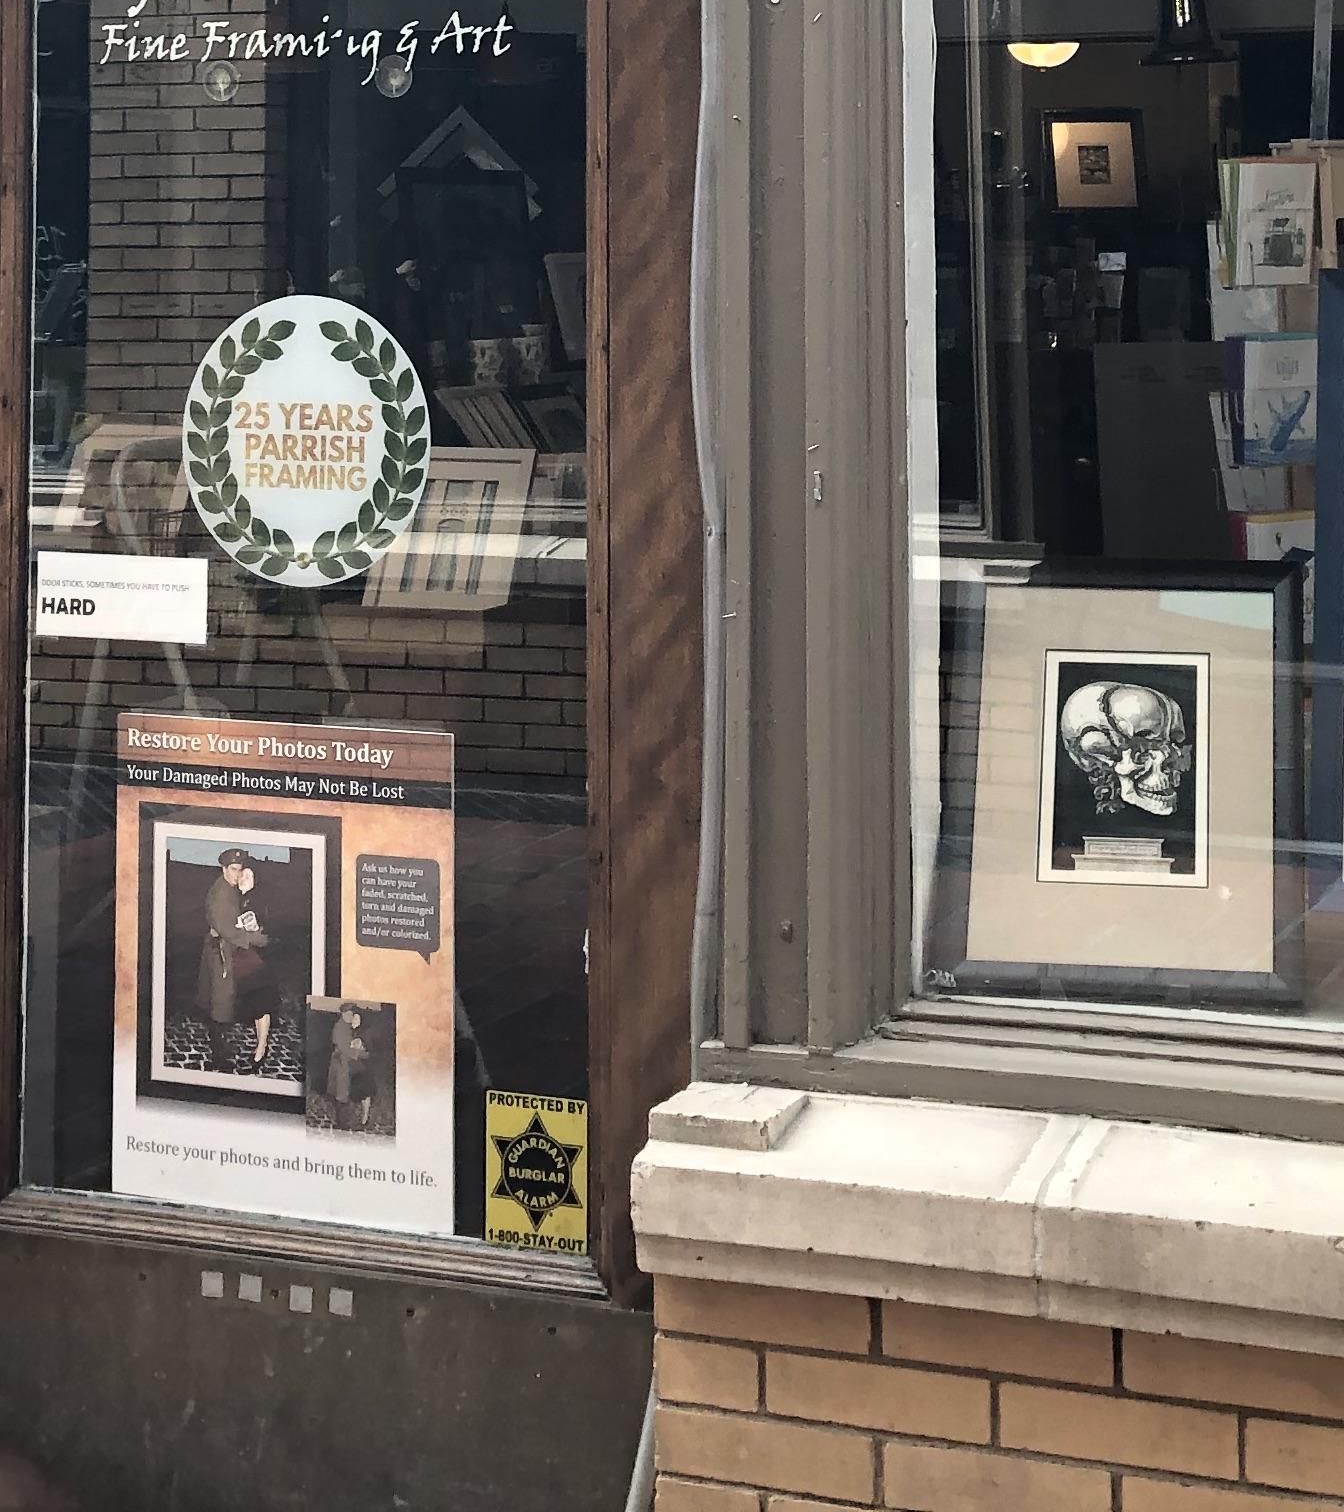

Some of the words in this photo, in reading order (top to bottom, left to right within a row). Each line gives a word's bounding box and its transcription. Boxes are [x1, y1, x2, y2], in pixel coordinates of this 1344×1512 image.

[100, 21, 192, 66] Fine
[396, 19, 421, 73] &
[430, 10, 514, 58] Art
[234, 401, 270, 431] 25
[279, 401, 374, 434] YEARS
[245, 432, 367, 464] PARRISH
[244, 462, 367, 492] FRAMING
[41, 578, 61, 587] DOOR
[86, 581, 126, 590] SOMETIMES
[127, 582, 141, 591] YOU
[142, 583, 159, 592] HAVE
[161, 583, 170, 592] TO
[171, 584, 190, 593] PUSH
[41, 597, 96, 616] HARD
[127, 727, 202, 753] Restore
[206, 733, 254, 756] Your
[257, 737, 327, 761] Photos
[332, 741, 394, 770] Today
[127, 764, 159, 783] Your
[162, 766, 228, 790] Damaged
[232, 771, 281, 792] Photos
[285, 775, 316, 797] May
[318, 778, 346, 796] Not
[349, 781, 369, 798] Be
[372, 783, 405, 800] Lost
[361, 862, 377, 872] Ask
[389, 865, 407, 875] how
[408, 868, 424, 878] you
[361, 877, 376, 885] can
[377, 877, 396, 887] have
[397, 879, 417, 889] your
[361, 888, 386, 899] faded,
[387, 891, 429, 903] scratched,
[361, 902, 379, 911] torn
[380, 902, 396, 912] and
[397, 904, 435, 917] damaged
[361, 914, 389, 924] photos
[390, 916, 425, 928] restored
[361, 926, 390, 937] and/or
[391, 929, 432, 941] colorized.
[488, 1092, 564, 1113] PROTECTED
[567, 1101, 585, 1115] BY
[126, 1134, 180, 1158] Restore
[182, 1143, 217, 1167] your
[219, 1146, 270, 1171] photos
[273, 1152, 300, 1173] and
[304, 1156, 345, 1182] bring
[348, 1163, 387, 1185] them
[390, 1168, 406, 1186] to
[409, 1167, 438, 1189] life.
[507, 1137, 566, 1170] GUARDIAN
[508, 1166, 565, 1184] BURGLAR
[514, 1189, 560, 1208] ALARM
[488, 1228, 584, 1252] 1-800-STAY-OUT
